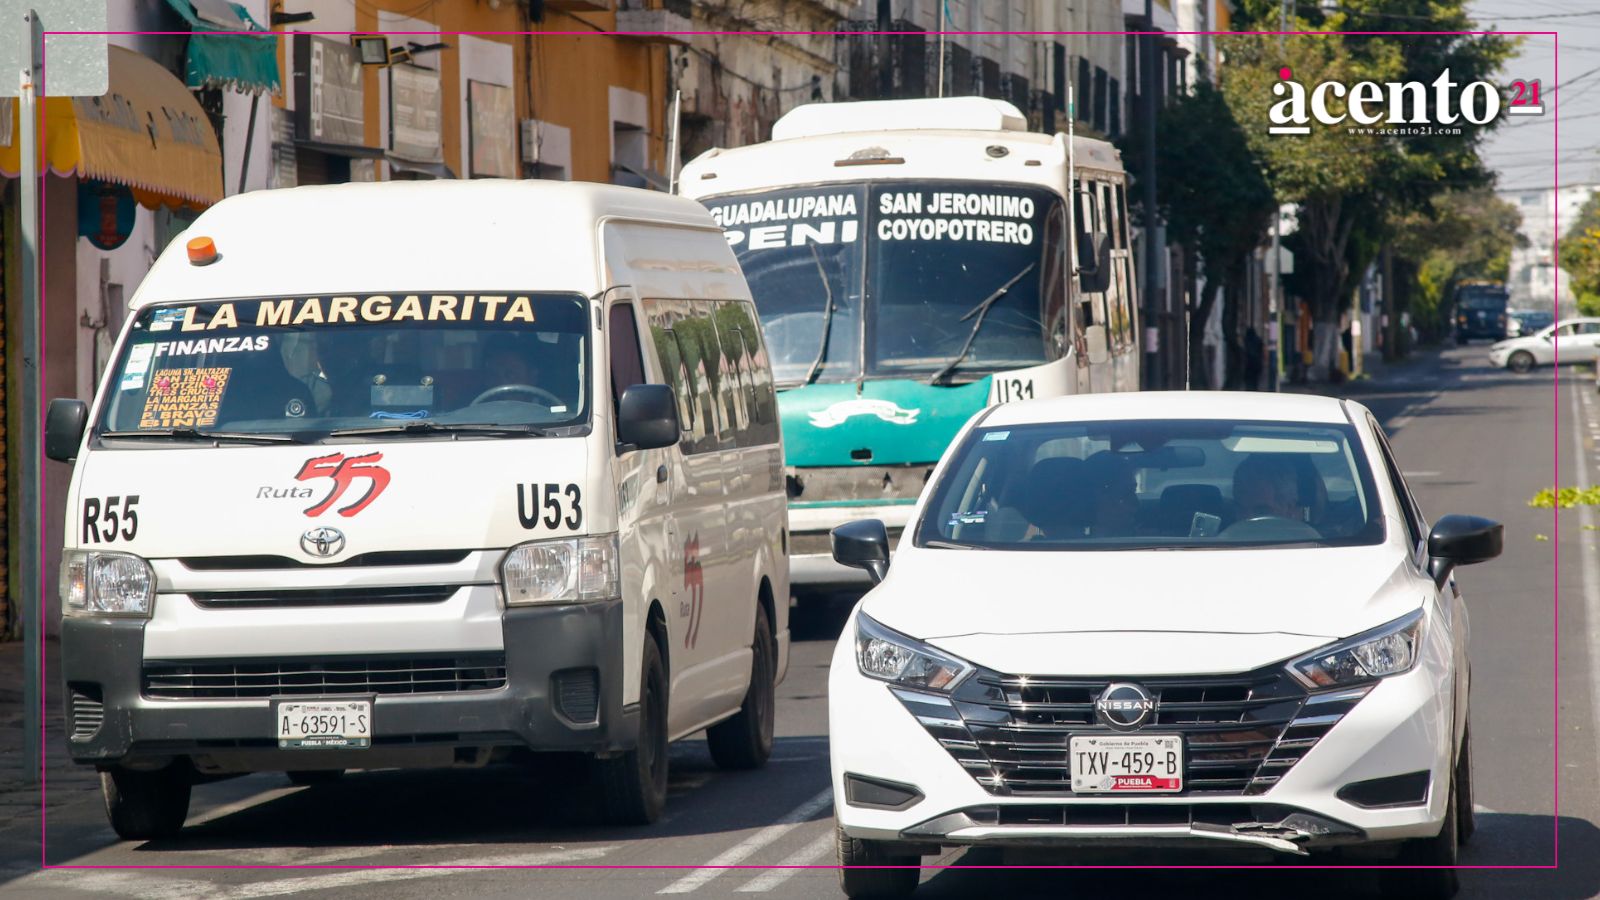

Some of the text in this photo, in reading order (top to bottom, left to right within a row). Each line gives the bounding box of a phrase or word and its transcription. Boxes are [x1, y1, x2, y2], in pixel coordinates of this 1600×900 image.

[710, 194, 857, 227] GUADALUPANA
[880, 193, 1035, 219] SAN JERONIMO
[877, 218, 1034, 246] COYOPOTRERO
[181, 303, 238, 332] LA
[255, 295, 536, 326] MARGARITA
[155, 335, 269, 357] FINANZAS
[155, 369, 182, 377] LAGUNA
[162, 395, 220, 404] MARGARITA
[180, 388, 223, 396] CRUCES
[997, 379, 1034, 403] U31
[144, 402, 219, 411] FINANZAS
[160, 410, 217, 419] BRAVO
[140, 418, 216, 427] BINE
[256, 452, 391, 517] Ruta 55
[516, 483, 583, 530] U53
[82, 495, 140, 544] R55
[1098, 701, 1153, 710] NISSAN
[282, 714, 367, 735] A-63591-S
[1077, 751, 1177, 775] TXV-459-B
[1118, 778, 1152, 786] PUEBLA
